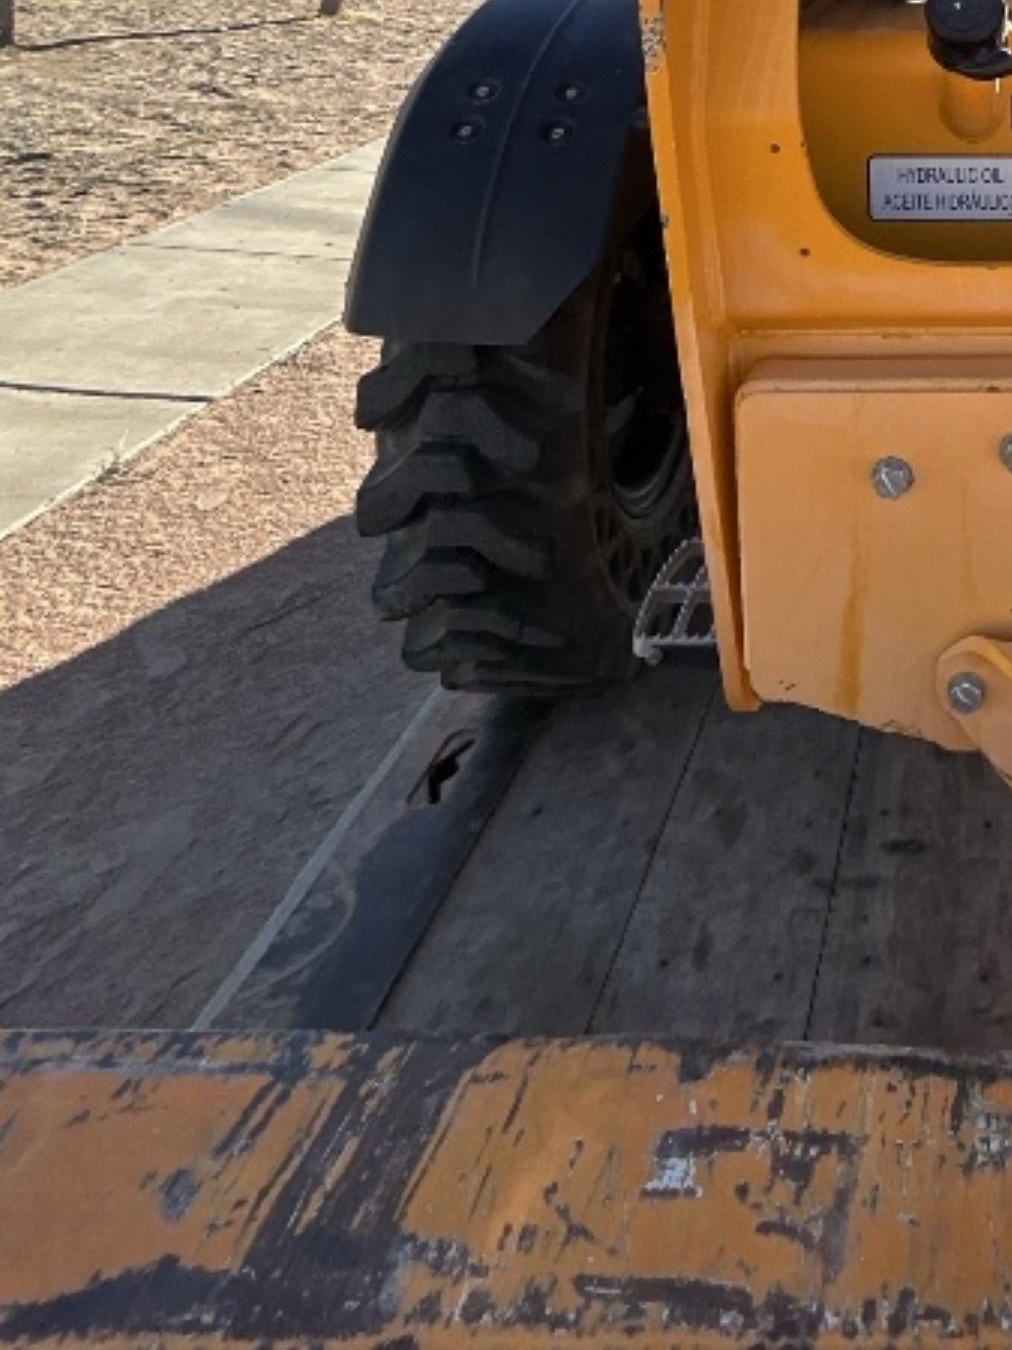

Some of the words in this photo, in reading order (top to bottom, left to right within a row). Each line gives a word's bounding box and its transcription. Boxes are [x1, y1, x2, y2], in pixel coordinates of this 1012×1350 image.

[896, 167, 978, 184] HYDRAULIC
[980, 167, 1005, 184] OIL
[882, 193, 933, 210] ACEITE
